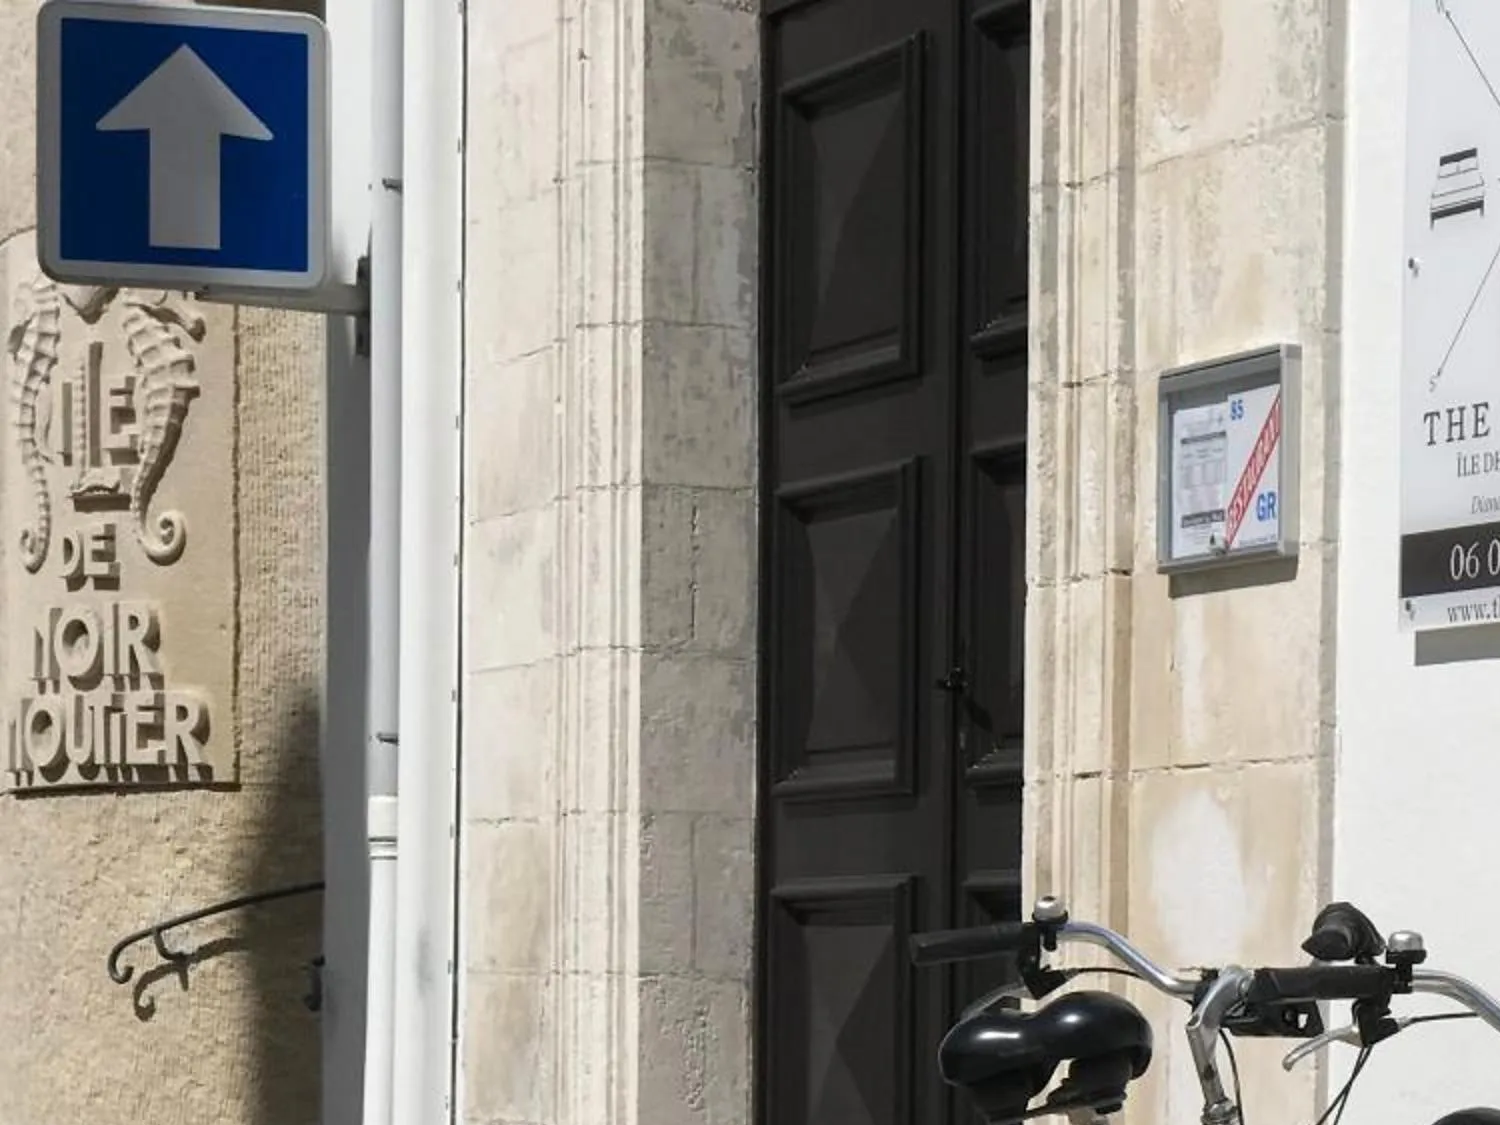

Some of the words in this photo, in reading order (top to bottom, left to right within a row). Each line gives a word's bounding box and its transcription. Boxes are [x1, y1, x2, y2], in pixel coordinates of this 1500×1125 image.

[1423, 401, 1491, 447] THE
[1256, 491, 1277, 522] GR
[57, 520, 122, 593] DE
[1450, 542, 1481, 581] 06
